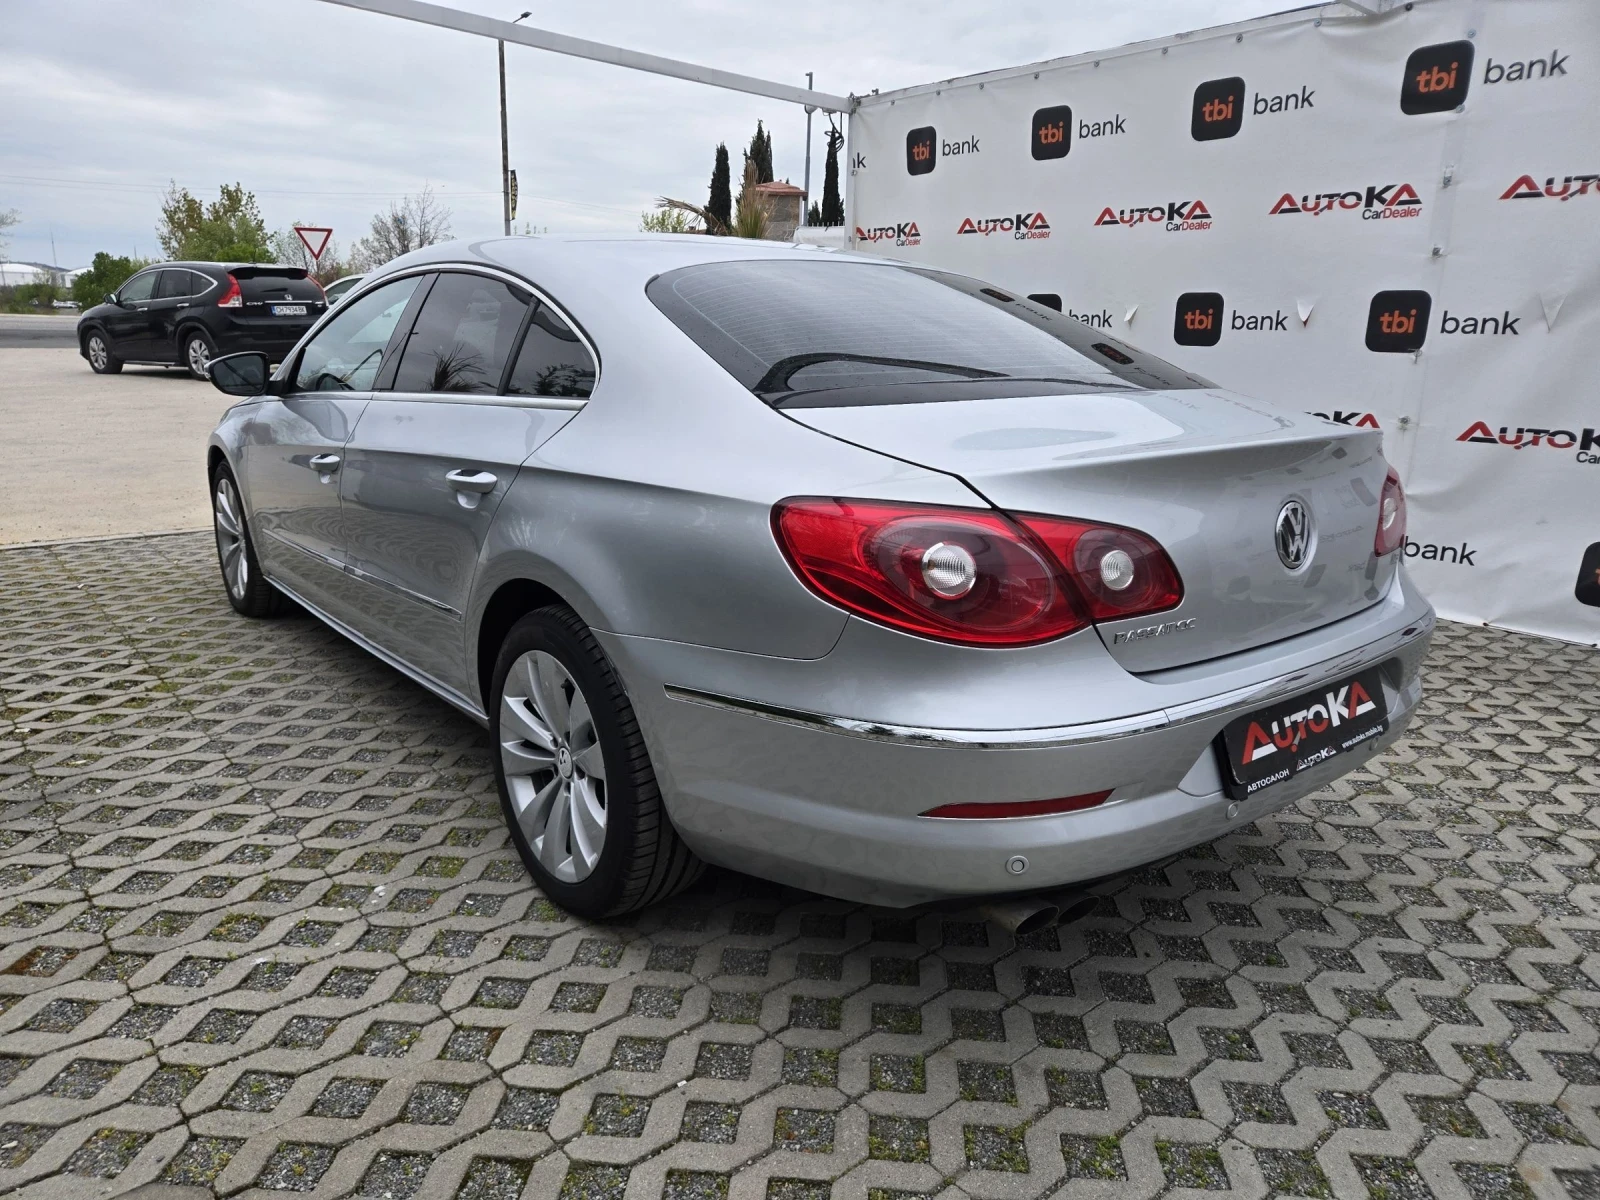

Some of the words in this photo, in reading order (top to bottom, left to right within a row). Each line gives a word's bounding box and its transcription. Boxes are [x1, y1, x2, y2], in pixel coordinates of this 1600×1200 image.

[1416, 62, 1459, 93] tbi
[1484, 49, 1571, 85] bank
[1202, 95, 1234, 122] tbi
[1253, 85, 1316, 115] bank
[1039, 121, 1064, 144] tbi
[1079, 114, 1126, 139] bank
[912, 140, 931, 161] tbi
[942, 135, 980, 157] bank
[1362, 206, 1422, 220] CarDealer
[1166, 220, 1212, 232] CarDealer
[1069, 310, 1113, 328] bank
[1184, 309, 1213, 330] tbi
[1231, 310, 1288, 331] bank
[1379, 309, 1417, 334] tbi
[1440, 310, 1521, 336] bank
[1404, 536, 1477, 566] bank
[1114, 622, 1175, 645] PASSAT
[1247, 768, 1290, 793] АВТОСАЛОН
